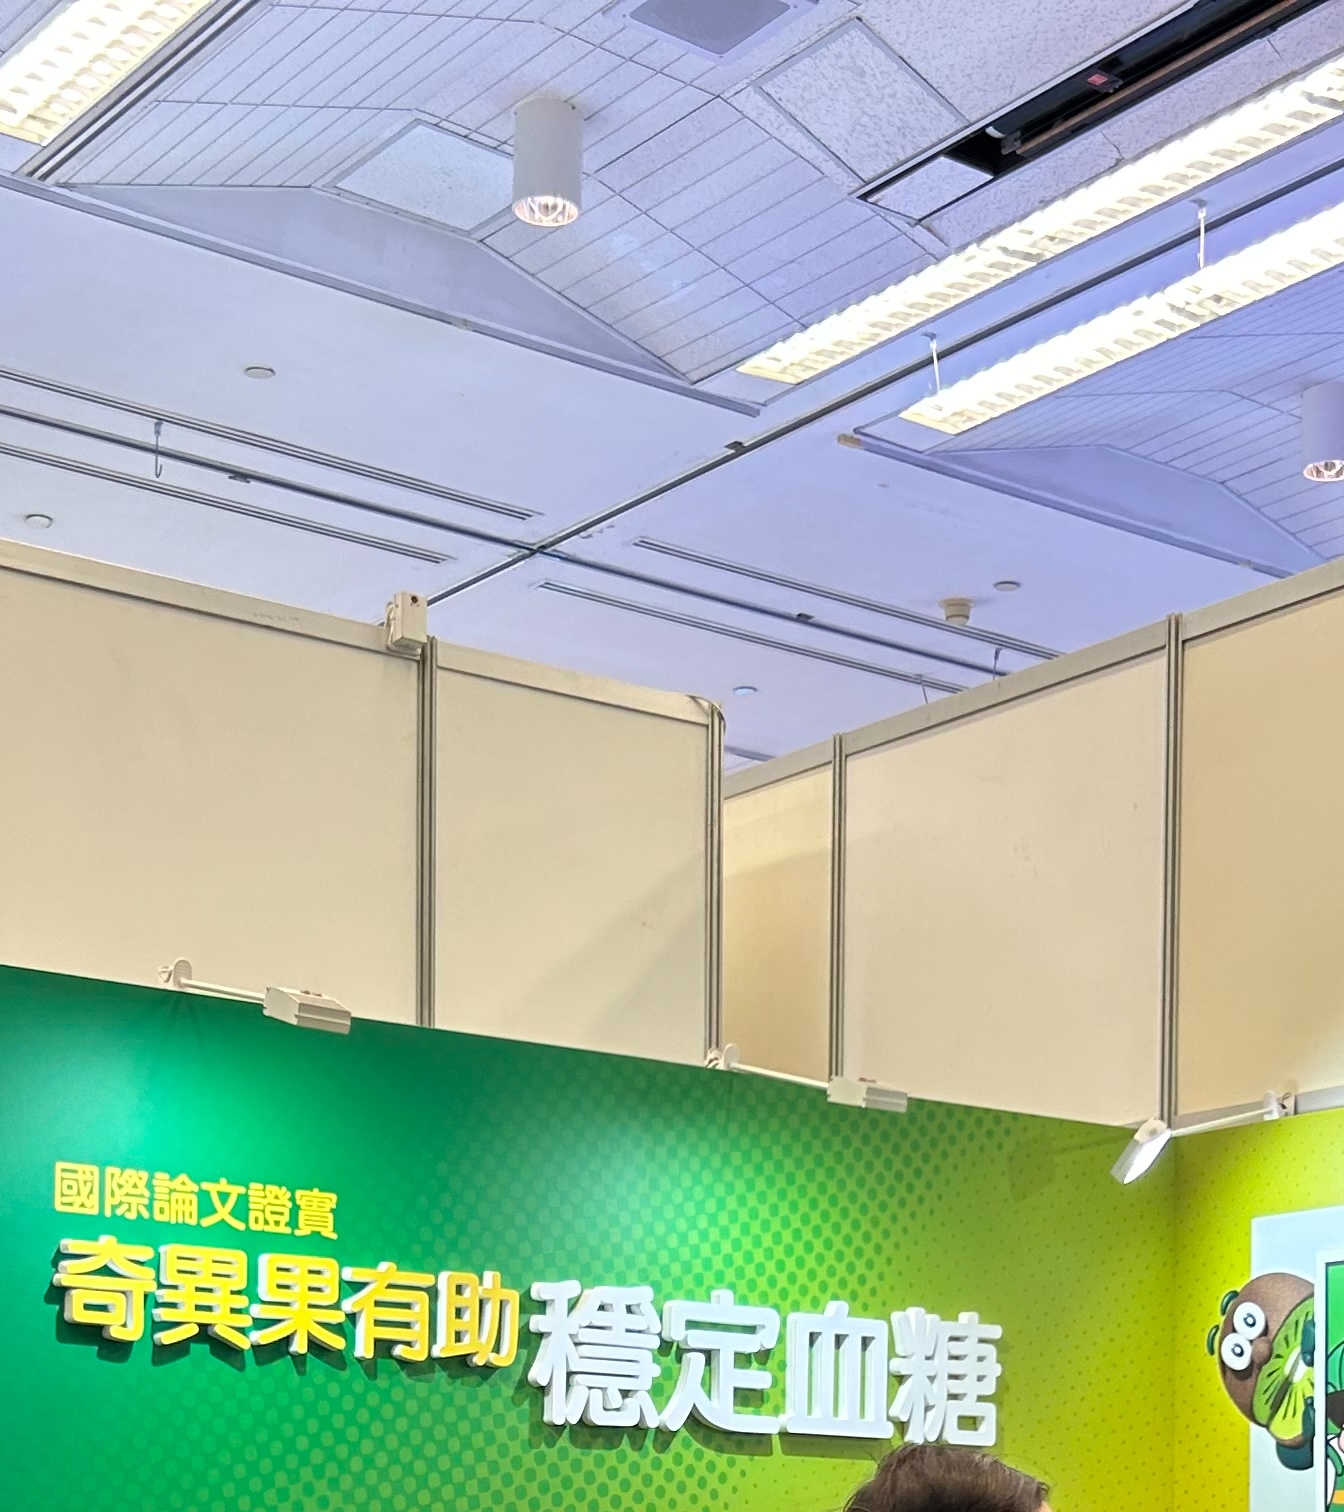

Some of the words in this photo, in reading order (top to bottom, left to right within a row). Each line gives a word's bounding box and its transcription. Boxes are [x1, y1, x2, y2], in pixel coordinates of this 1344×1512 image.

[54, 1162, 339, 1241] 國際論文證實
[53, 1234, 1002, 1446] 奇異果有助穩定血糖
